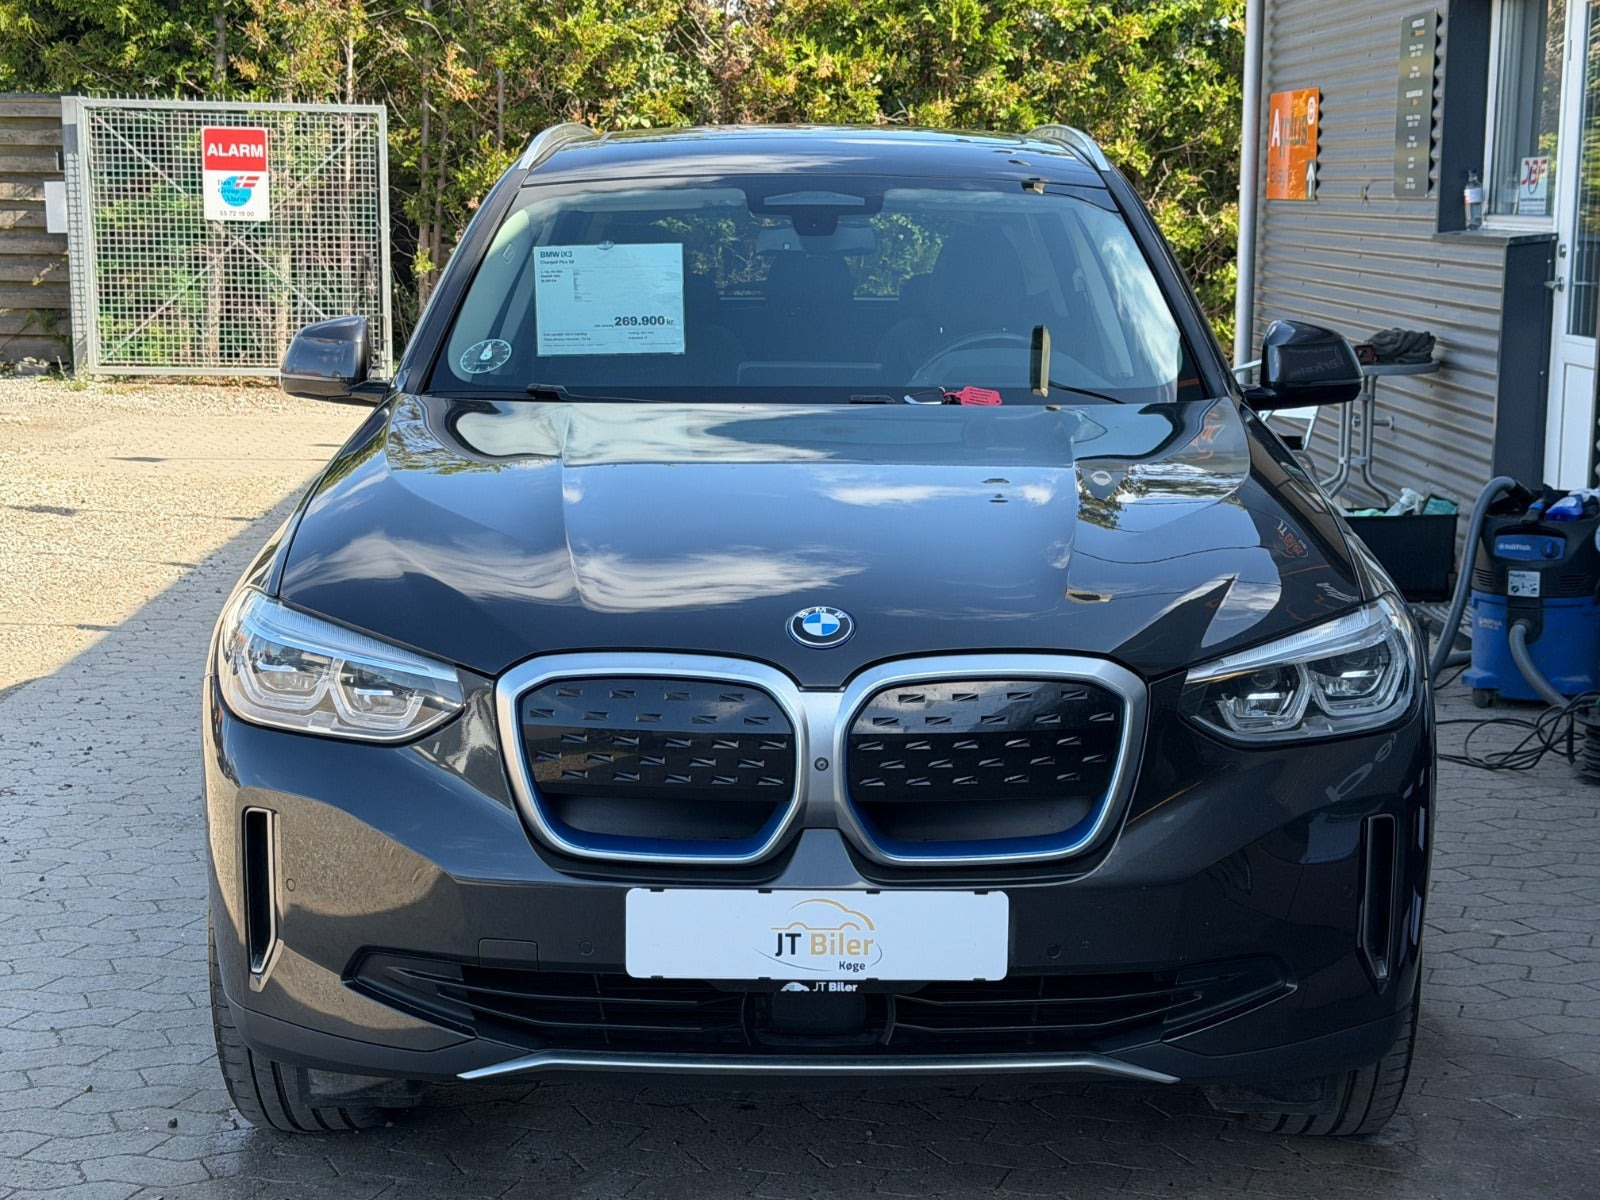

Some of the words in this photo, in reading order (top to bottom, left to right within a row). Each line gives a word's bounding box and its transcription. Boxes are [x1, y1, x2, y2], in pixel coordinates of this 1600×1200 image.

[207, 143, 264, 157] ALARM
[614, 315, 665, 326] 269.900
[666, 318, 676, 326] kr.
[1504, 543, 1532, 551] Nilfisk
[775, 932, 802, 957] JT
[810, 932, 874, 956] Biler
[838, 961, 866, 972] Køge
[812, 981, 827, 992] JT
[828, 981, 858, 992] Biler
